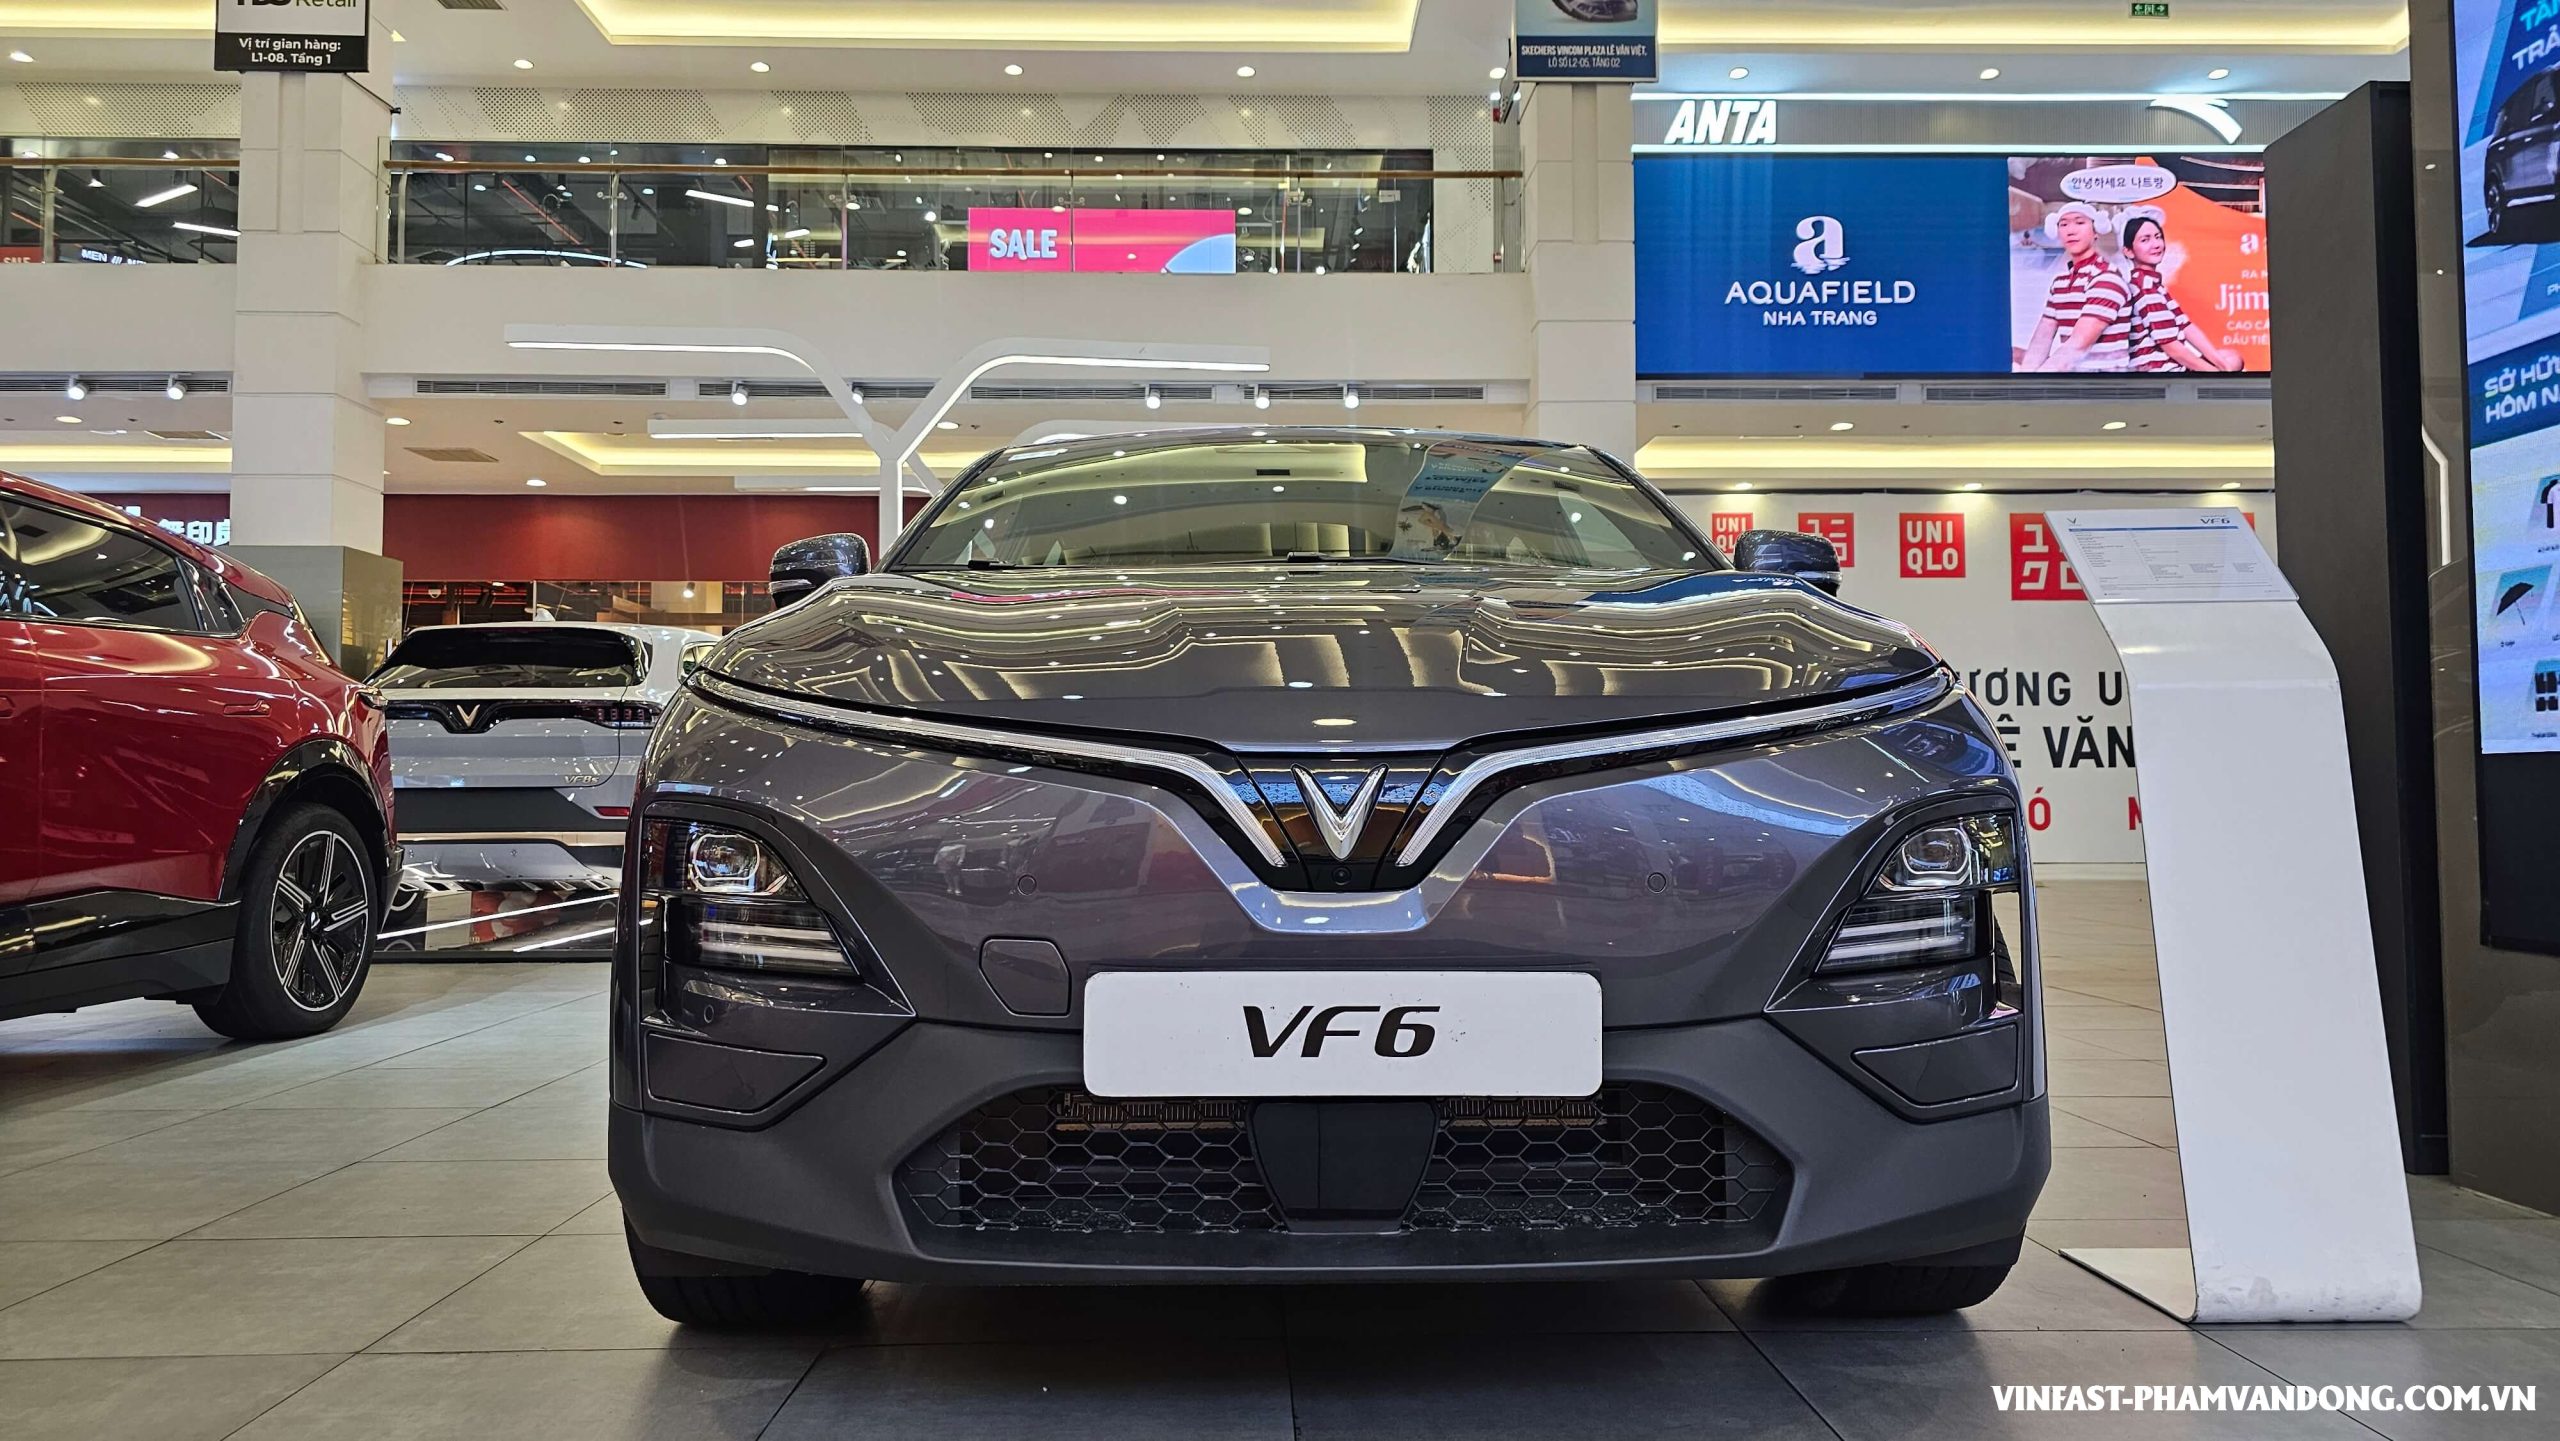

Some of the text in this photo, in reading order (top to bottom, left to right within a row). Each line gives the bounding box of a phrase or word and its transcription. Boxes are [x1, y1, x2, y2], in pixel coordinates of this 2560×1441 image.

[239, 38, 341, 52] Vị trí gian hàng:
[1521, 45, 1557, 56] SKECHERS
[1557, 45, 1583, 55] VINCOM
[1584, 45, 1605, 55] PLAZA
[1606, 44, 1615, 55] LÊ
[251, 53, 288, 63] L1-08.
[326, 54, 331, 64] 1
[1610, 58, 1620, 67] 02
[1663, 99, 1777, 145] ANTA
[2071, 177, 2126, 189] 안녕하세요
[989, 228, 1058, 259] SALE
[81, 249, 107, 262] MEN
[1724, 280, 1916, 305] AQUAFIELD
[1763, 310, 1878, 326] NHA TRANG
[2226, 321, 2253, 331] CAO
[2485, 384, 2560, 423] HÔM N
[1716, 517, 1747, 532] UNI
[1906, 520, 1953, 544] UNI
[1716, 534, 1738, 554] QL
[2021, 523, 2050, 553] ユ
[1906, 548, 1959, 575] QLO
[2042, 715, 2137, 769] VĂN
[1242, 1005, 1441, 1057] VF6
